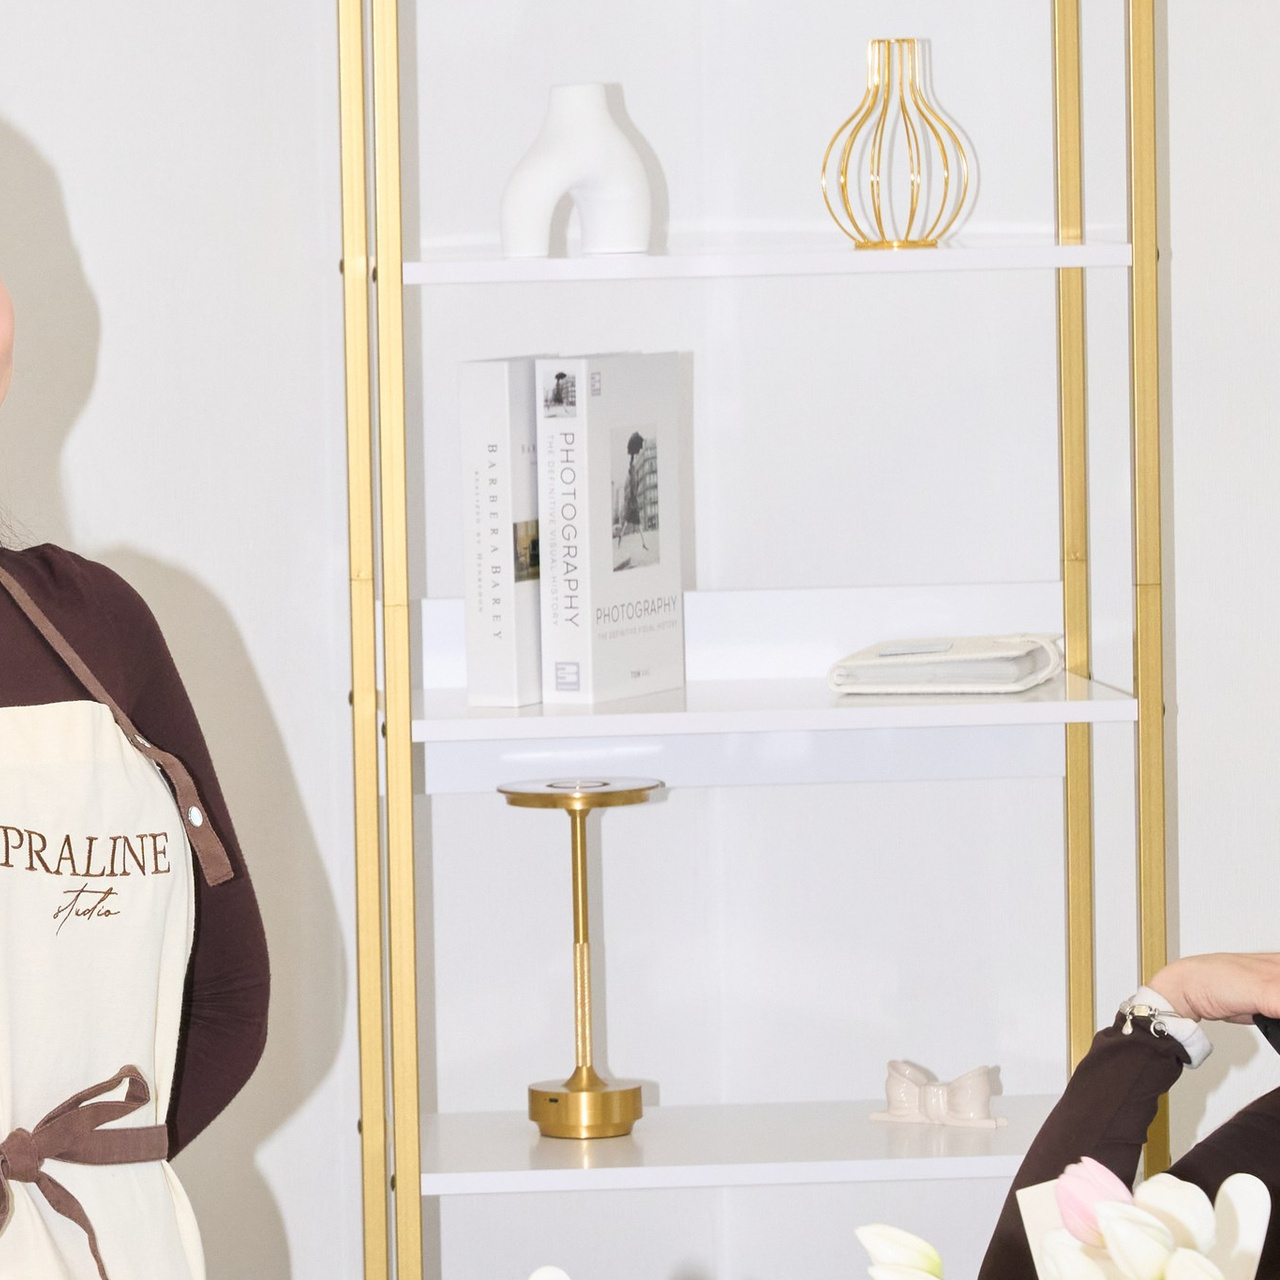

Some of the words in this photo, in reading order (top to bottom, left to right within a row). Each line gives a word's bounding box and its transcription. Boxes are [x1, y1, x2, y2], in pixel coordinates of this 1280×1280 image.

[546, 434, 556, 456] THE
[486, 444, 500, 554] BARBERA
[547, 460, 557, 526] DEFINITIVE
[549, 529, 558, 572] VISUAL
[559, 431, 580, 629] PHOTOGRAPHY
[490, 565, 503, 641] BAREY
[550, 575, 559, 627] HISTORY
[595, 595, 678, 625] PHOTOGRAPHY
[52, 882, 121, 937] studio
